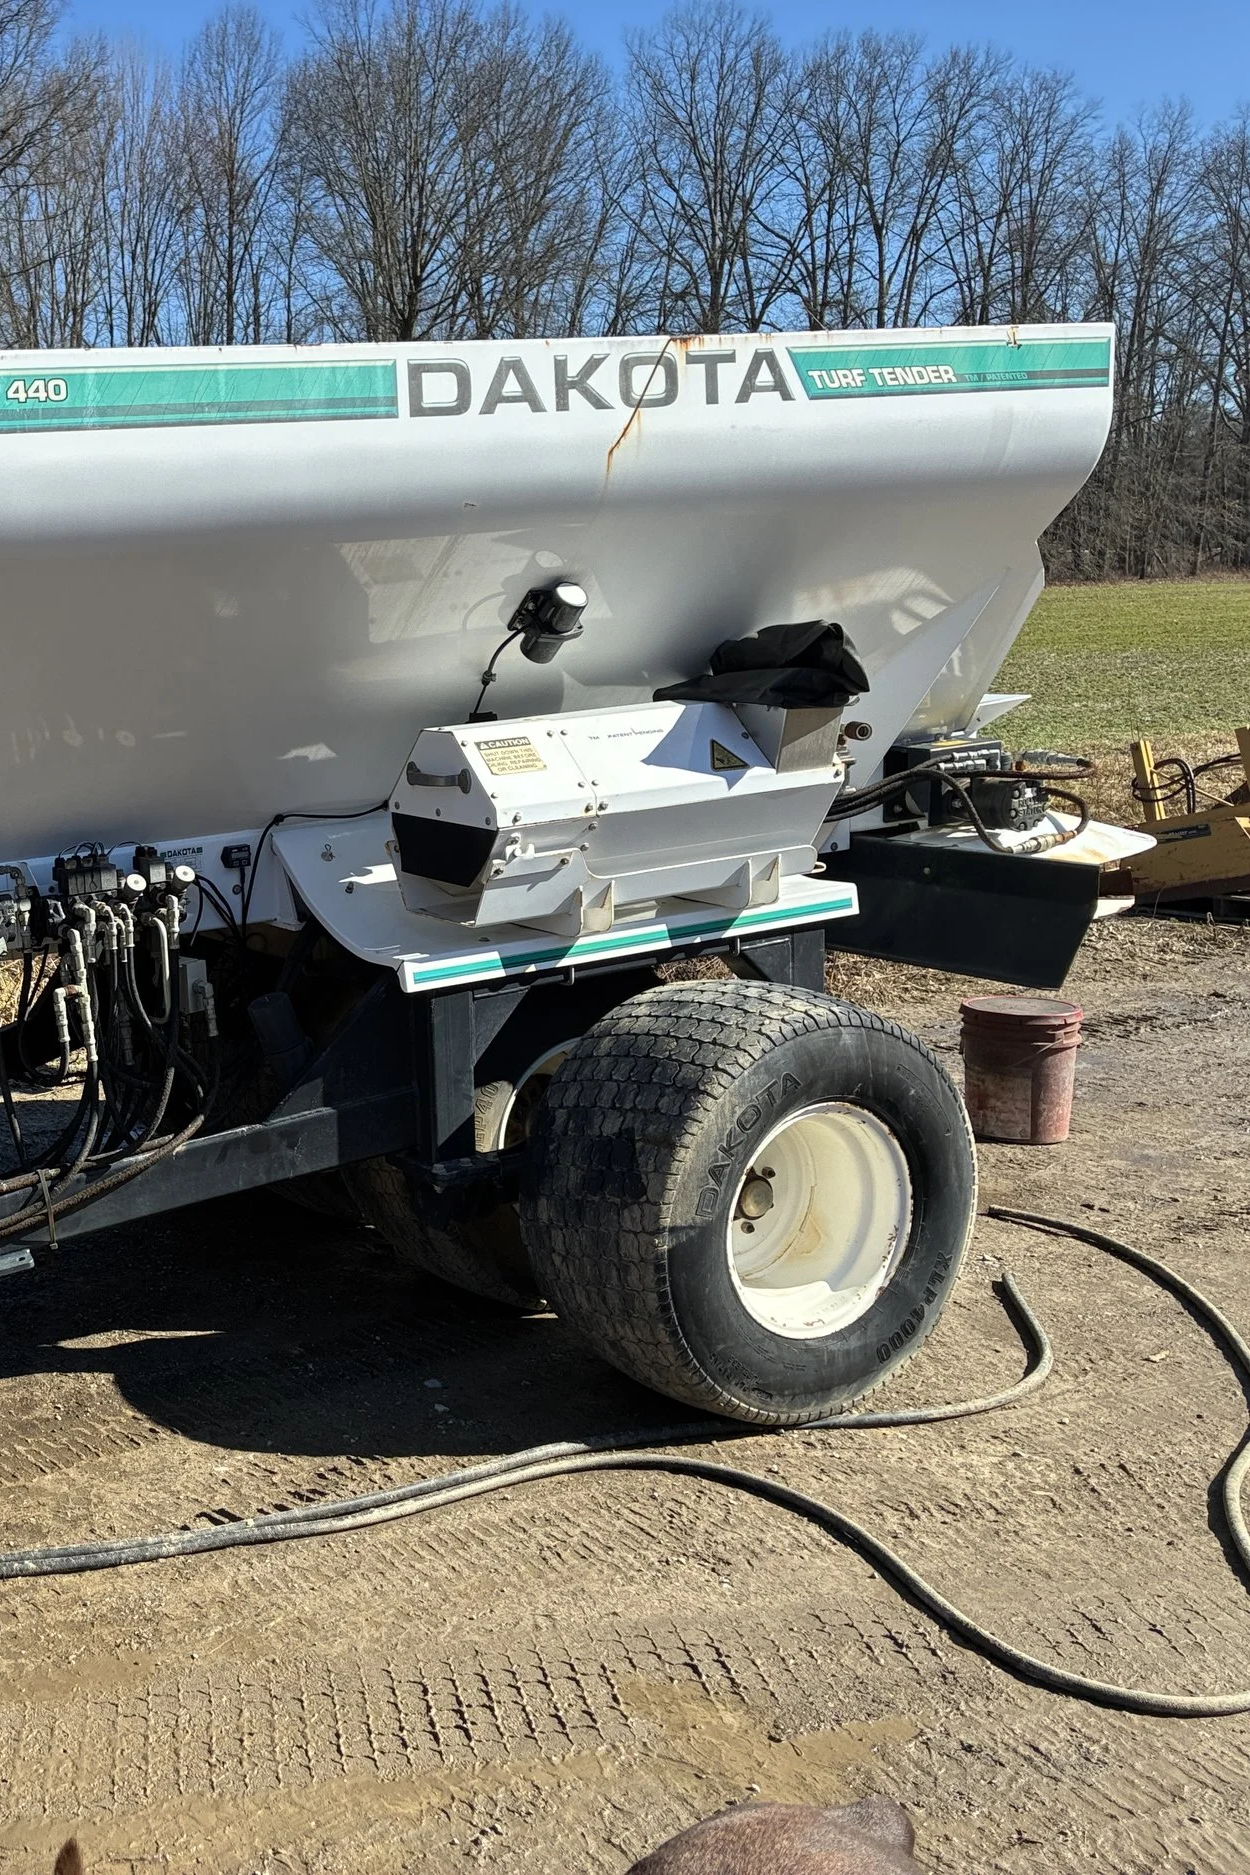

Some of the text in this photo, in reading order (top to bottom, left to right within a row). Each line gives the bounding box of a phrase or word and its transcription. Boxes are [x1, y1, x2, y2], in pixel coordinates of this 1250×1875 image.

[6, 377, 69, 404] 440
[407, 347, 797, 418] DAKOTA
[806, 367, 867, 390] TURF
[868, 364, 958, 387] TENDER
[985, 371, 1029, 382] PATENTED
[488, 738, 530, 749] CAUTION
[167, 847, 197, 858] DAKOTA
[694, 1071, 803, 1222] DAKOTA
[876, 1250, 953, 1365] XLP4000
